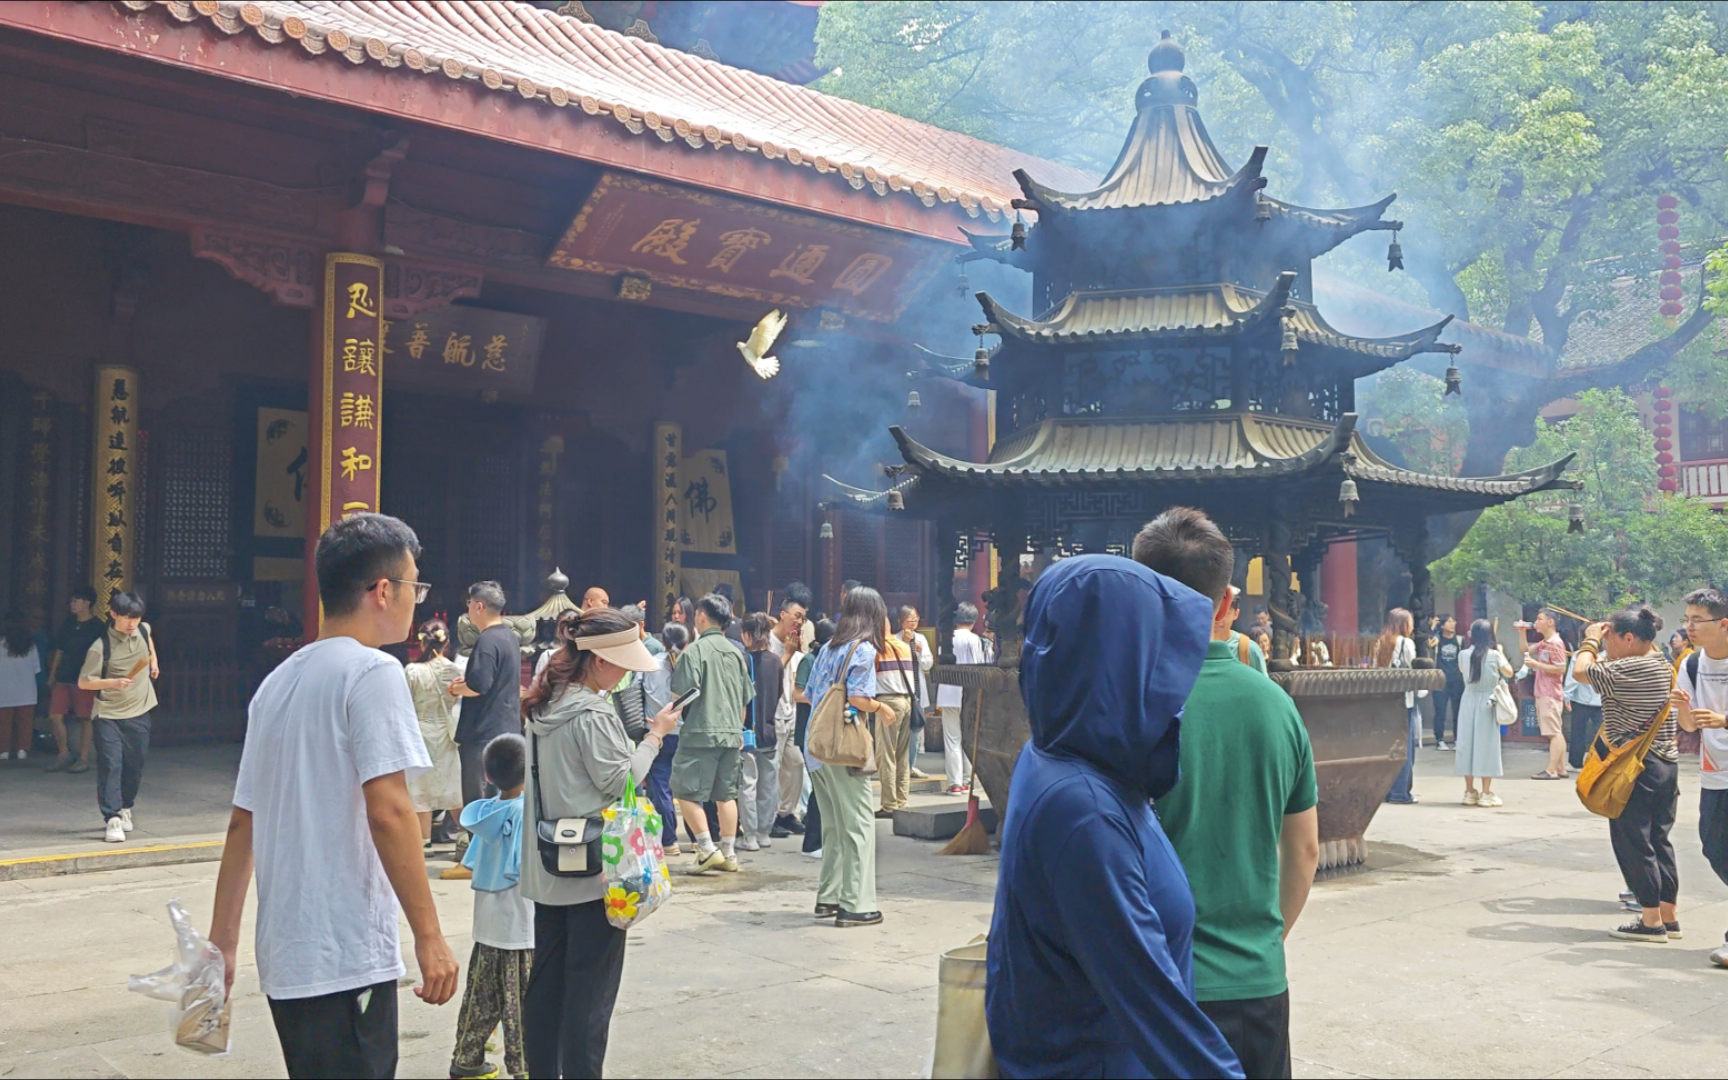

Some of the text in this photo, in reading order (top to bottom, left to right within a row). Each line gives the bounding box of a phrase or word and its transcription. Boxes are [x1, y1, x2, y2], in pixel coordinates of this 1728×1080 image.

[104, 378, 130, 604] 慈航達彼岸以自在
